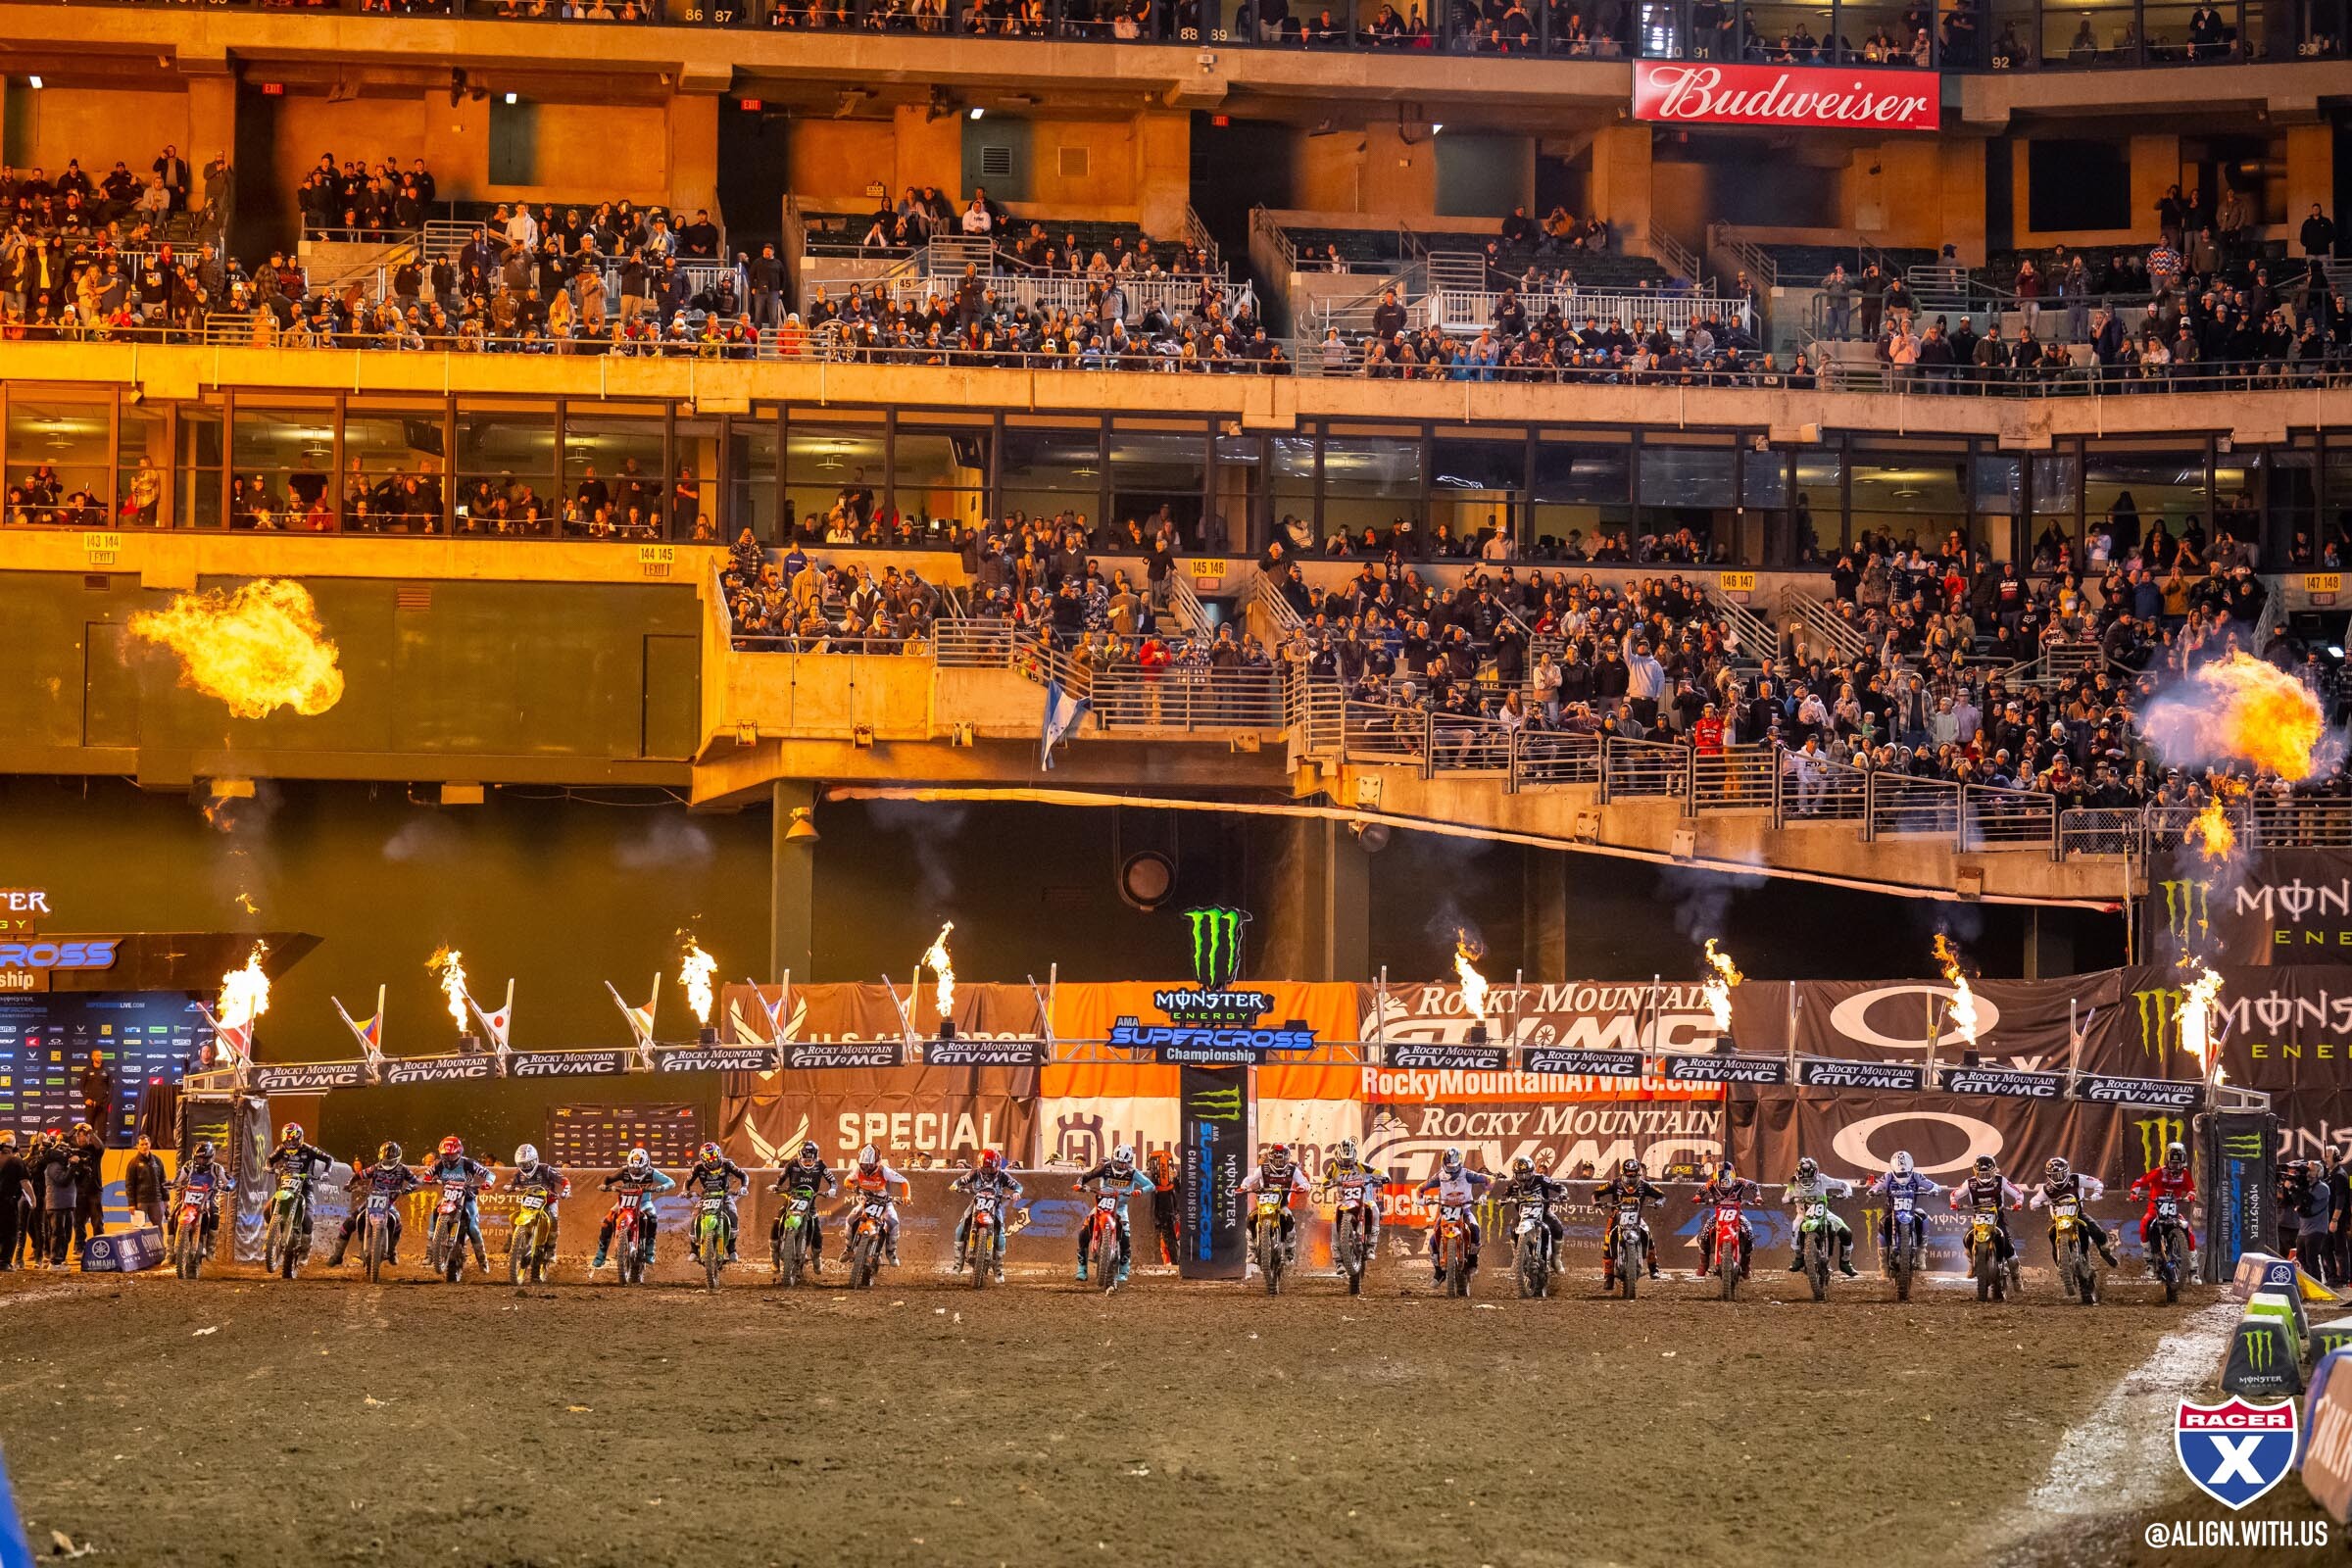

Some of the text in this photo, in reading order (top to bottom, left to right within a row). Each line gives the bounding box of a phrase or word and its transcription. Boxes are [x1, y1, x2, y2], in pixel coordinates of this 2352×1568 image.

[685, 9, 703, 22] 86
[714, 11, 732, 23] 87
[1180, 27, 1199, 40] 88
[1693, 47, 1709, 59] 91
[1992, 57, 2010, 69] 92
[1649, 67, 1928, 122] Budweiser
[743, 100, 759, 110] EXIT
[86, 535, 119, 548] 143 144
[641, 548, 673, 561] 144 145
[649, 564, 665, 574] EXIT
[1193, 562, 1224, 574] 145 146
[1723, 575, 1753, 587] 146 147
[2306, 576, 2339, 588] 147 148
[1155, 990, 1266, 1009] MONSTER
[1117, 1017, 1139, 1027] AMA
[1108, 1028, 1316, 1049] SUPERCROSS
[808, 1045, 893, 1055] ROCKY MOUNTAIN
[946, 1042, 1033, 1052] ROCKY MOUNTAIN
[1411, 1045, 1499, 1057] ROCKY MOUNTAIN
[530, 1053, 615, 1063] ROCKY MOUNTAIN
[677, 1050, 763, 1059] ROCKY MOUNTAIN
[1166, 1048, 1256, 1063] Championship
[1547, 1051, 1635, 1063] ROCKY MOUNTAIN
[273, 1064, 358, 1076] ROCKY MOUNTAIN
[404, 1058, 488, 1070] ROCKY MOUNTAIN
[1690, 1057, 1778, 1071] ROCKY MOUNTAIN
[1827, 1063, 1915, 1078] ROCKY MOUNTAIN
[1968, 1071, 2056, 1086] ROCKY MOUNTAIN
[2107, 1078, 2194, 1094] ROCKY MOUNTAIN
[1415, 1105, 1722, 1137] ROCKY MOUNTAIN
[839, 1112, 1004, 1151] SPECIAL
[1187, 1151, 1197, 1231] CHAMPIONSHIP
[1224, 1154, 1239, 1228] MONSTER
[1344, 1188, 1362, 1200] 33
[184, 1192, 204, 1204] 162
[367, 1195, 386, 1208] 173
[523, 1196, 544, 1208] 85
[620, 1195, 639, 1206] 111
[976, 1198, 994, 1209] 84
[1098, 1198, 1116, 1209] 49
[703, 1199, 721, 1210] 508
[790, 1199, 808, 1211] 79
[865, 1203, 884, 1218] 41
[1549, 1202, 1605, 1215] ONSTER
[1806, 1203, 1826, 1217] 48
[1893, 1199, 1913, 1210] 56
[2159, 1202, 2177, 1216] 43
[1443, 1207, 1462, 1220] 34
[1521, 1206, 1543, 1218] 24
[1718, 1209, 1738, 1221] 18
[2250, 1184, 2259, 1239] MONSTER
[1620, 1211, 1639, 1225] 83
[1975, 1213, 1995, 1225] 53
[2238, 1374, 2282, 1385] MONSTER
